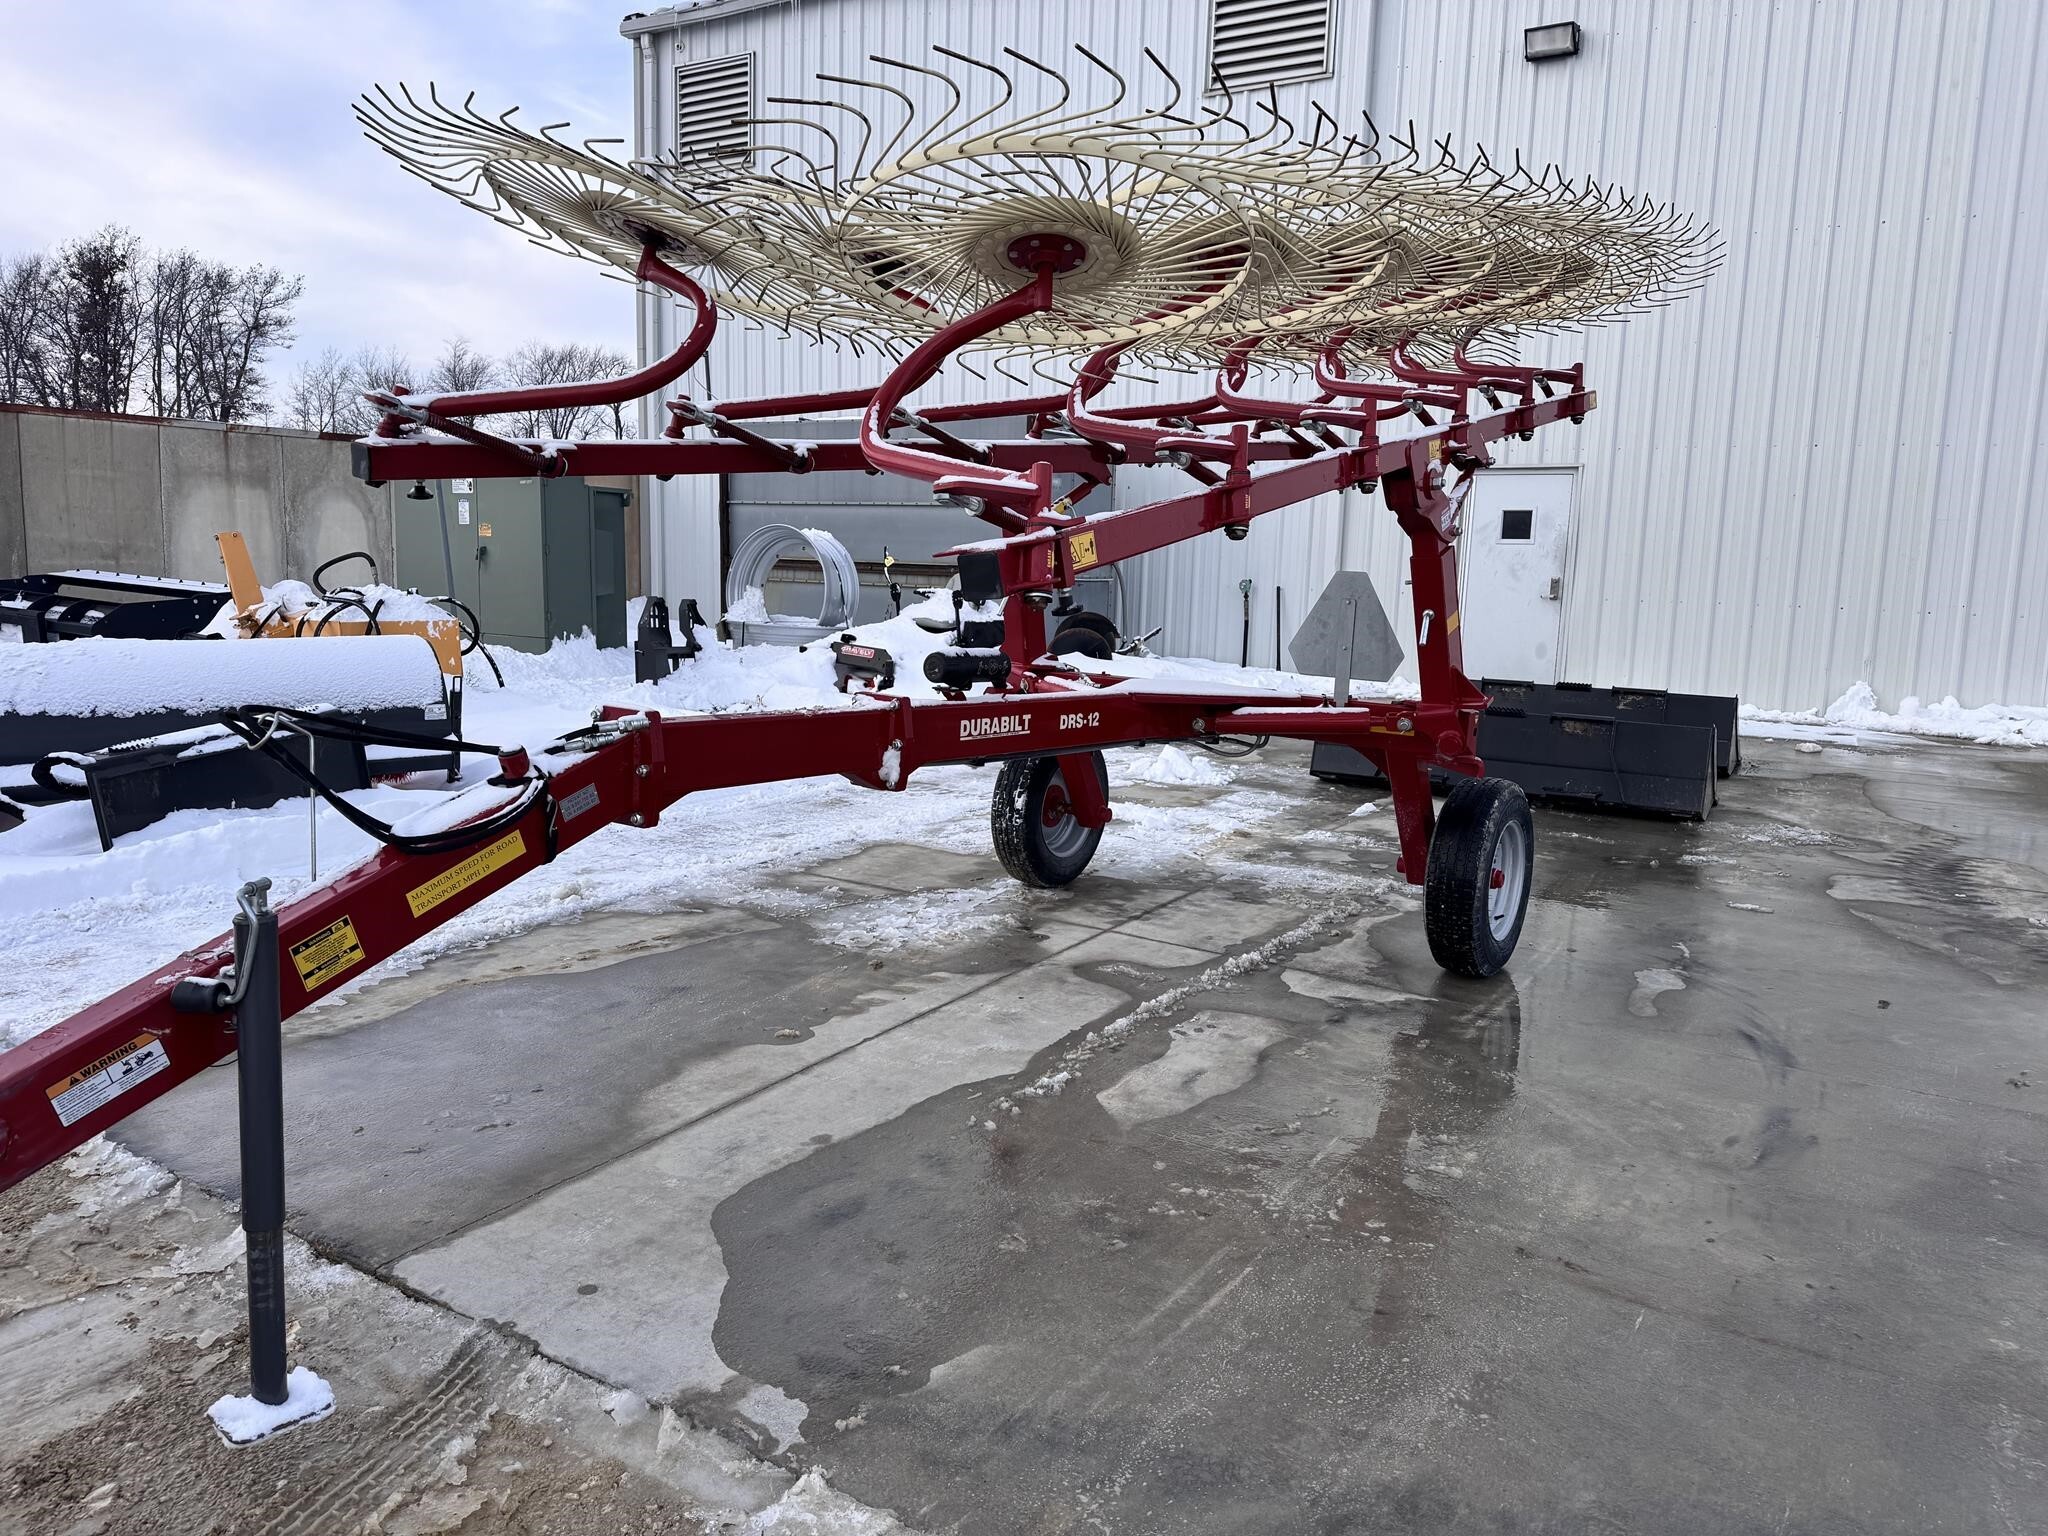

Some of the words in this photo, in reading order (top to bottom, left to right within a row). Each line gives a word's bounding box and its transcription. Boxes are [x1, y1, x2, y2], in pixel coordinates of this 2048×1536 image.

[960, 714, 1032, 737] DURABILT
[1059, 712, 1100, 730] DRS-12
[411, 873, 454, 902] MAXIMUM
[455, 858, 480, 877] SPEED
[479, 849, 496, 862] FOR
[496, 835, 518, 852] ROAD
[415, 880, 462, 912] TRANSPORT
[463, 870, 482, 885] MPH
[481, 863, 490, 873] 19
[79, 1042, 138, 1078] WARNING
